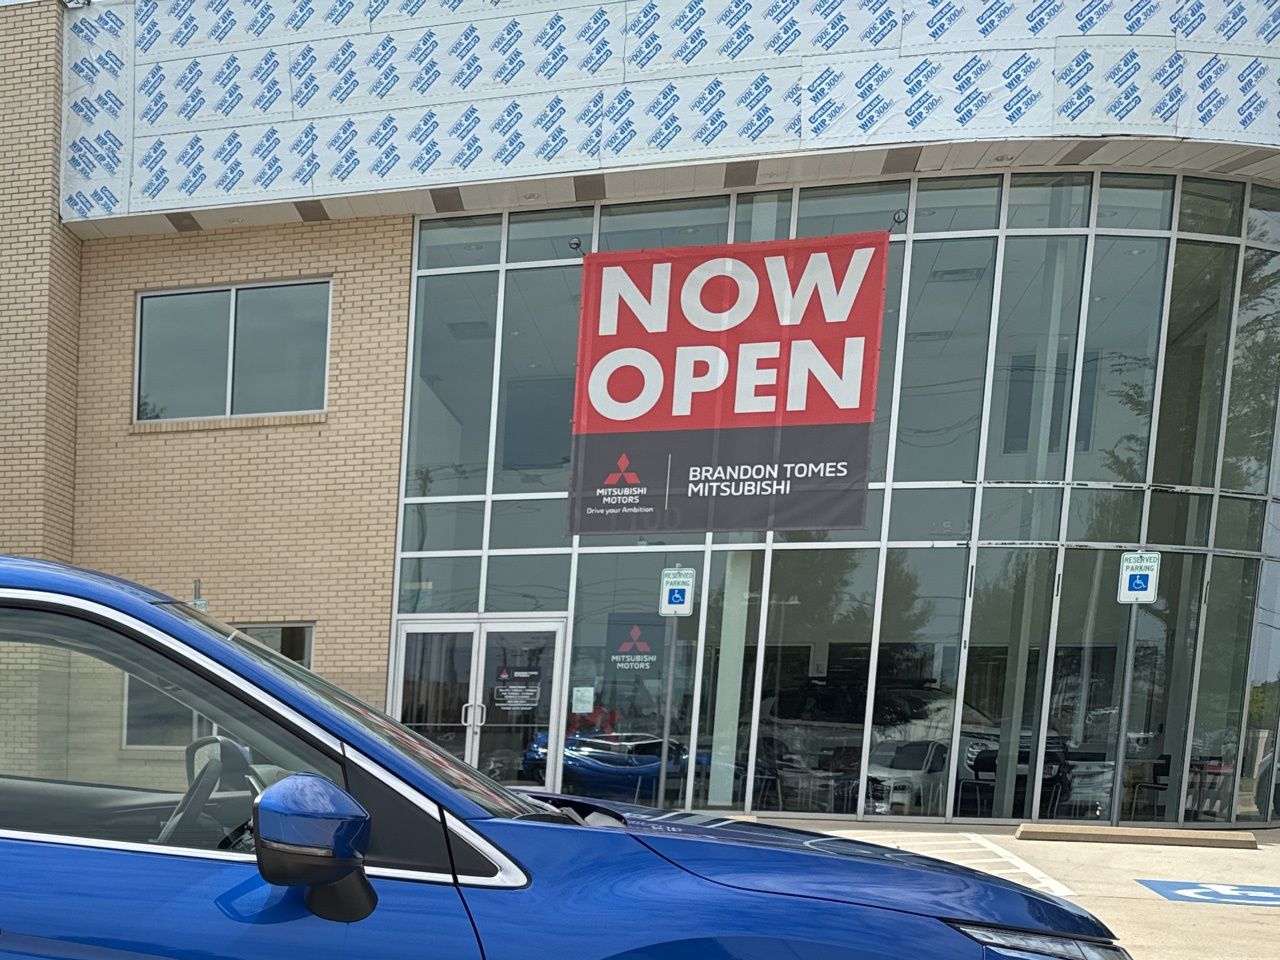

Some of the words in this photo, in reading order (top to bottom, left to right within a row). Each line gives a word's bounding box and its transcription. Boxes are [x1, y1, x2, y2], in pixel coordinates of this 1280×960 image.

[643, 3, 658, 18] WIP
[688, 0, 703, 14] WIP
[1232, 5, 1246, 20] WIP
[549, 15, 563, 31] WIP
[593, 9, 607, 25] WIP
[830, 14, 846, 31] WIP
[879, 10, 895, 26] WIP
[1078, 17, 1094, 32] WIP
[1126, 17, 1142, 32] WIP
[736, 24, 751, 40] WIP
[783, 19, 798, 35] WIP
[929, 22, 946, 38] WIP
[979, 19, 996, 35] WIP
[1029, 17, 1046, 34] WIP
[422, 31, 435, 46] WIP
[645, 34, 659, 49] WIP
[690, 29, 705, 45] WIP
[595, 40, 609, 55] WIP
[1075, 52, 1091, 67] WIP
[1124, 52, 1139, 67] WIP
[708, 80, 722, 96] WIP
[754, 75, 769, 91] WIP
[906, 80, 922, 96] WIP
[955, 76, 971, 92] WIP
[1004, 74, 1021, 90] WIP
[1197, 75, 1212, 90] WIP
[1238, 78, 1253, 94] WIP
[662, 85, 677, 100] WIP
[809, 88, 825, 103] WIP
[857, 84, 873, 100] WIP
[1076, 85, 1093, 100] WIP
[1124, 85, 1140, 100] WIP
[506, 102, 520, 118] WIP
[756, 106, 771, 122] WIP
[956, 109, 972, 124] WIP
[1005, 107, 1022, 122] WIP
[1198, 108, 1212, 124] WIP
[664, 115, 679, 131] WIP
[710, 111, 725, 126] WIP
[858, 115, 874, 131] WIP
[907, 112, 923, 127] WIP
[1238, 111, 1253, 127] WIP
[620, 120, 634, 135] WIP
[810, 119, 826, 134] WIP
[190, 136, 202, 151] WIP
[598, 247, 876, 336] NOW
[588, 336, 865, 421] OPEN
[688, 464, 778, 481] BRANDON
[783, 462, 848, 478] TOMES
[596, 487, 647, 496] MITSUBISHI
[687, 480, 791, 497] MITSUBISHI
[602, 496, 640, 504] MOTORS
[605, 508, 621, 516] your
[611, 654, 657, 662] MITSUBISHI
[616, 662, 650, 670] MOTORS
